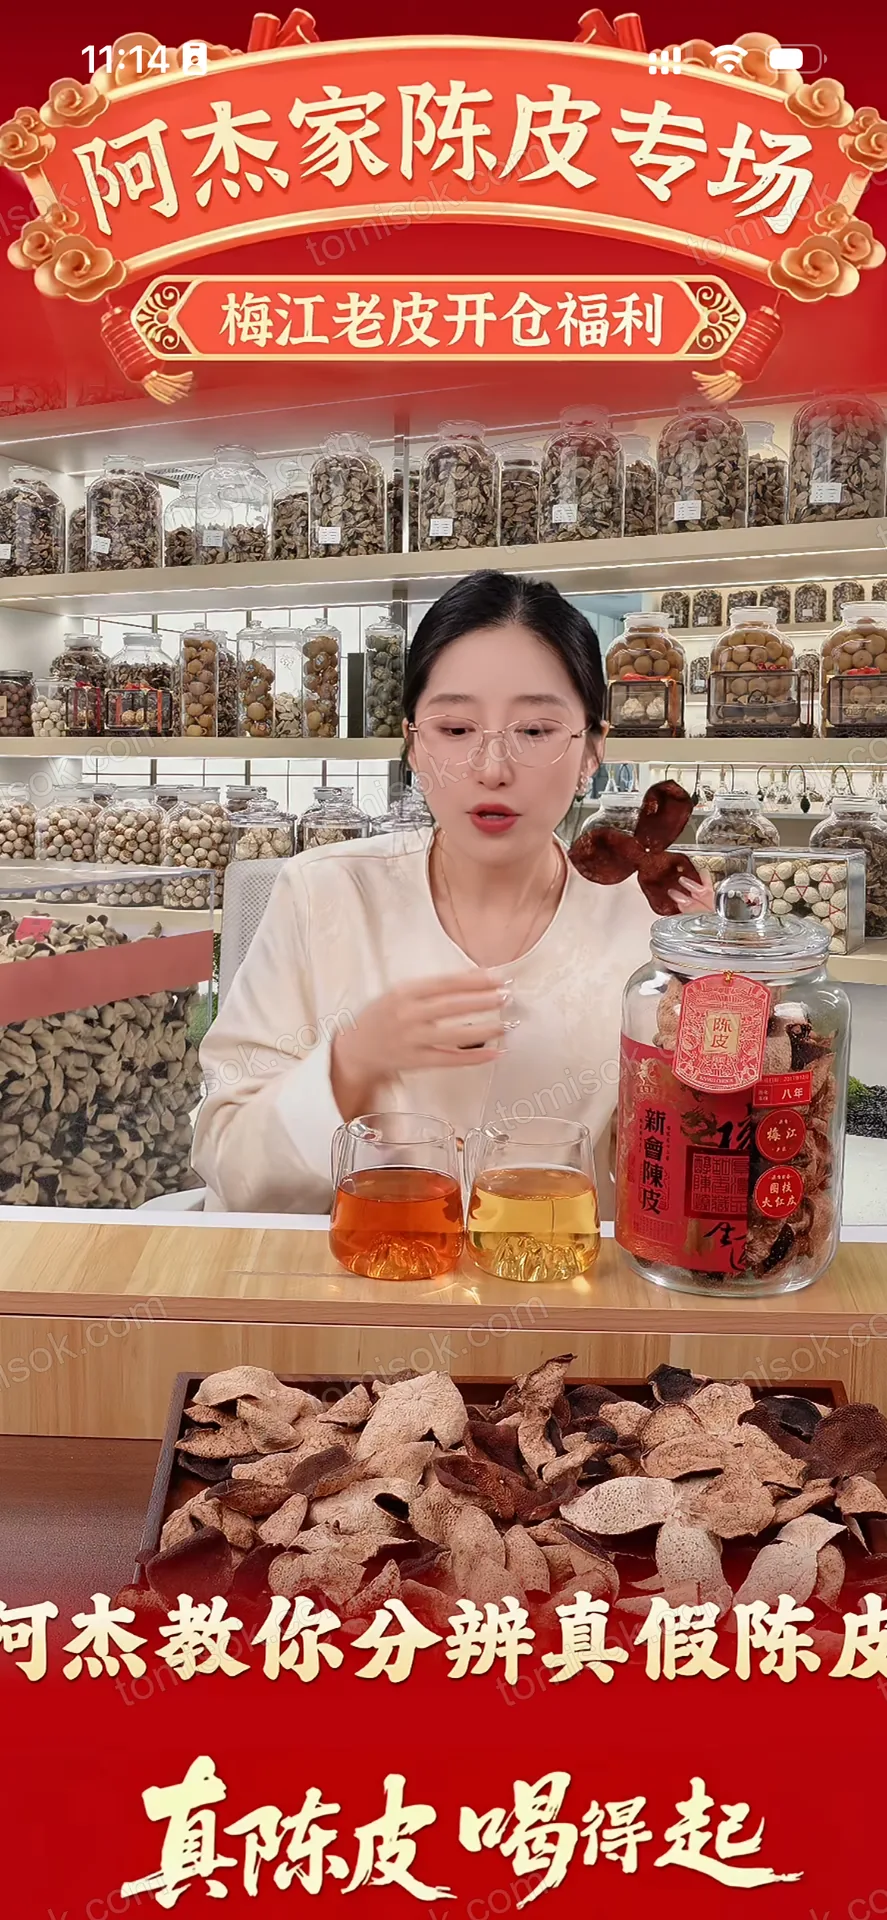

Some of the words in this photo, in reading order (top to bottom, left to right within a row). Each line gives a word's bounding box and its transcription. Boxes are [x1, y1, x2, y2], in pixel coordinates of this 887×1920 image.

[781, 1087, 803, 1100] 八年
[767, 1127, 797, 1142] 梅江
[641, 1107, 666, 1215] 新會陳皮
